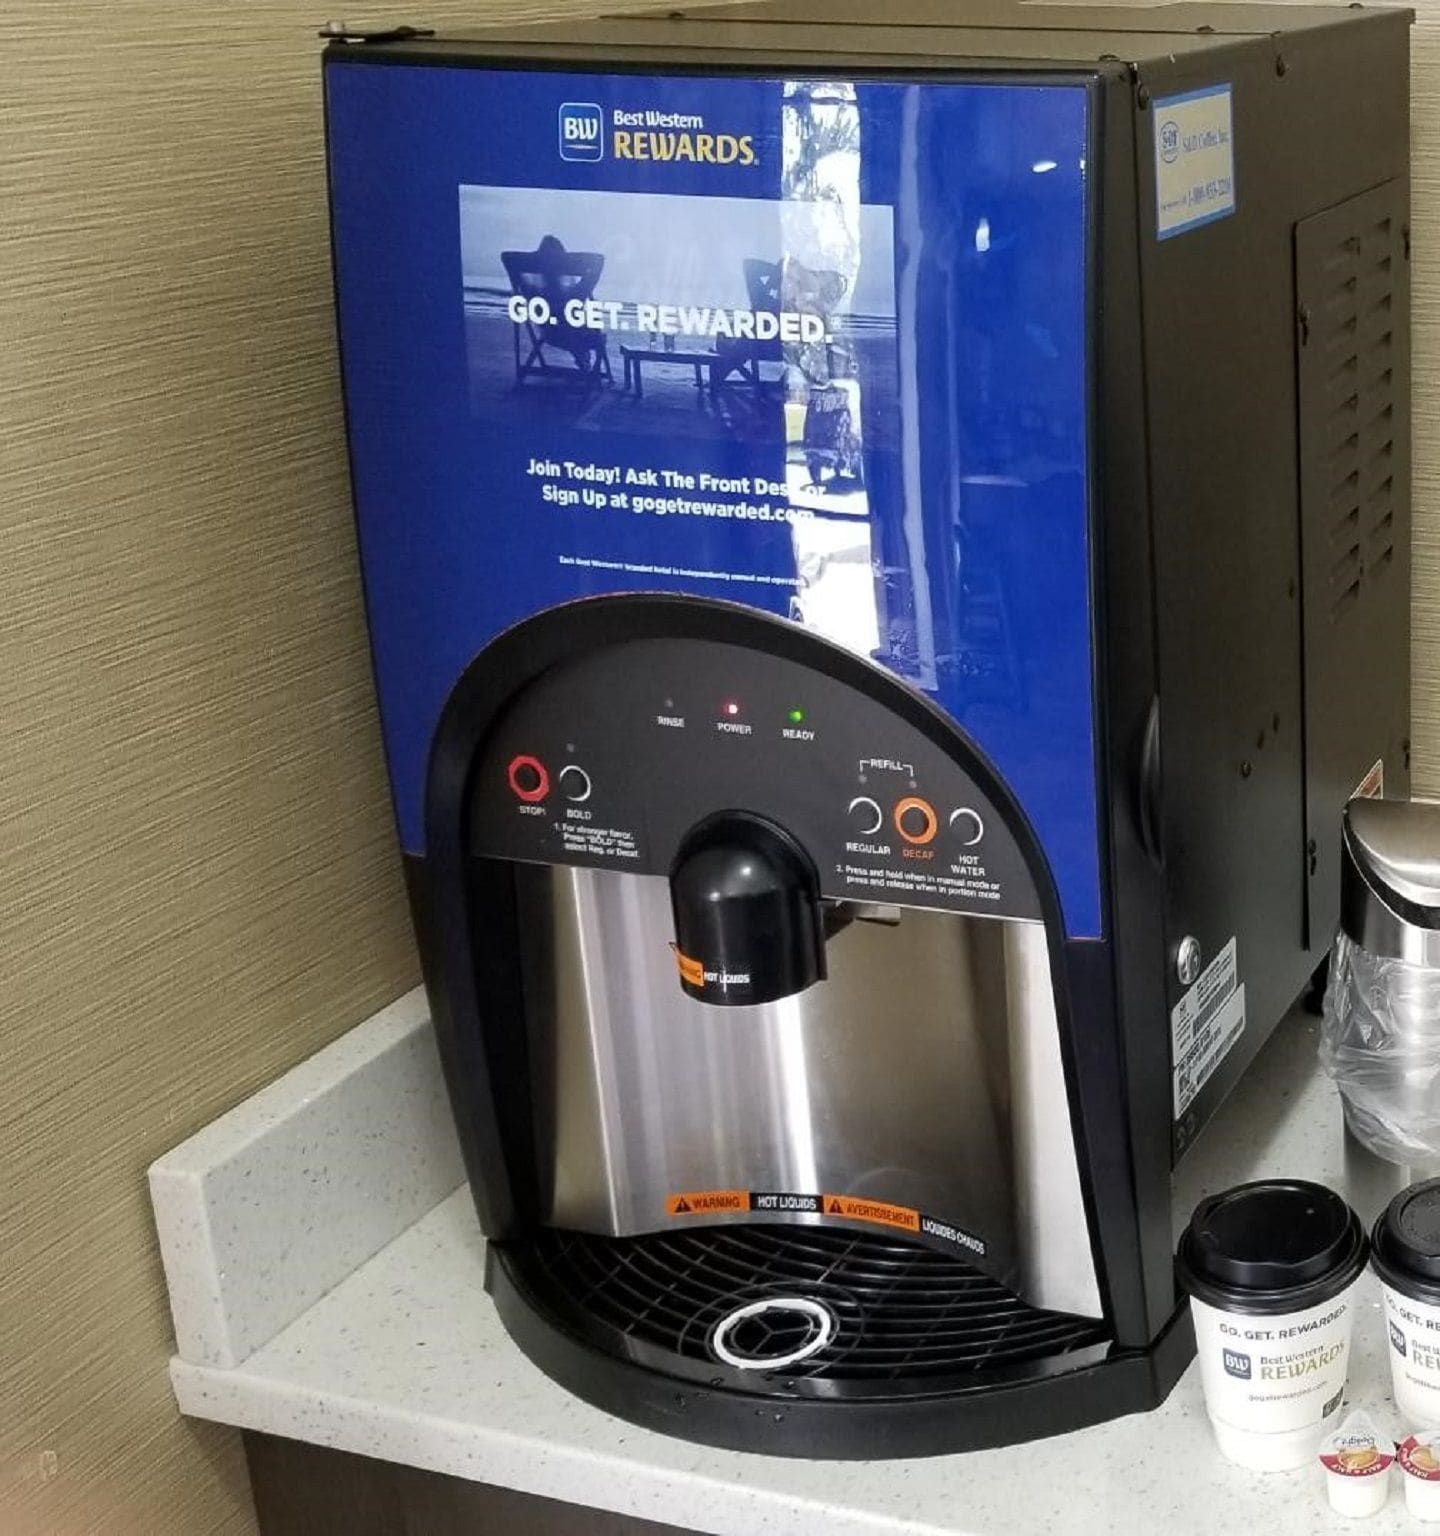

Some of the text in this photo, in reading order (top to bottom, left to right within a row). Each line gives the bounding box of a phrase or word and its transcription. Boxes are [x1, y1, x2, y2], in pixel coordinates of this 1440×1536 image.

[613, 109, 704, 129] Best Western
[564, 117, 598, 141] BW
[508, 295, 557, 325] GO.
[564, 298, 628, 330] GET.
[526, 458, 827, 499] Join Today! Ask The Front Des or
[542, 484, 815, 522] Sign Up at gogetrewarded.com
[717, 722, 752, 735] POWER
[782, 728, 815, 741] READY
[870, 758, 904, 771] REFILL
[566, 808, 592, 820] BOLD
[846, 842, 935, 860] REGULAR DECAF
[959, 855, 980, 866] HOT
[869, 866, 884, 877] and
[885, 868, 903, 880] hold
[904, 871, 926, 881] when
[951, 865, 986, 877] WATER
[719, 974, 750, 984] LIQUIDS
[695, 1196, 985, 1255] WARNING HOT LIQUIDS AVERTISSEMENT LIQUIDES CHAUDS
[1244, 1330, 1275, 1341] GET.
[1226, 1354, 1249, 1371] BW
[1261, 1345, 1324, 1365] Best Western
